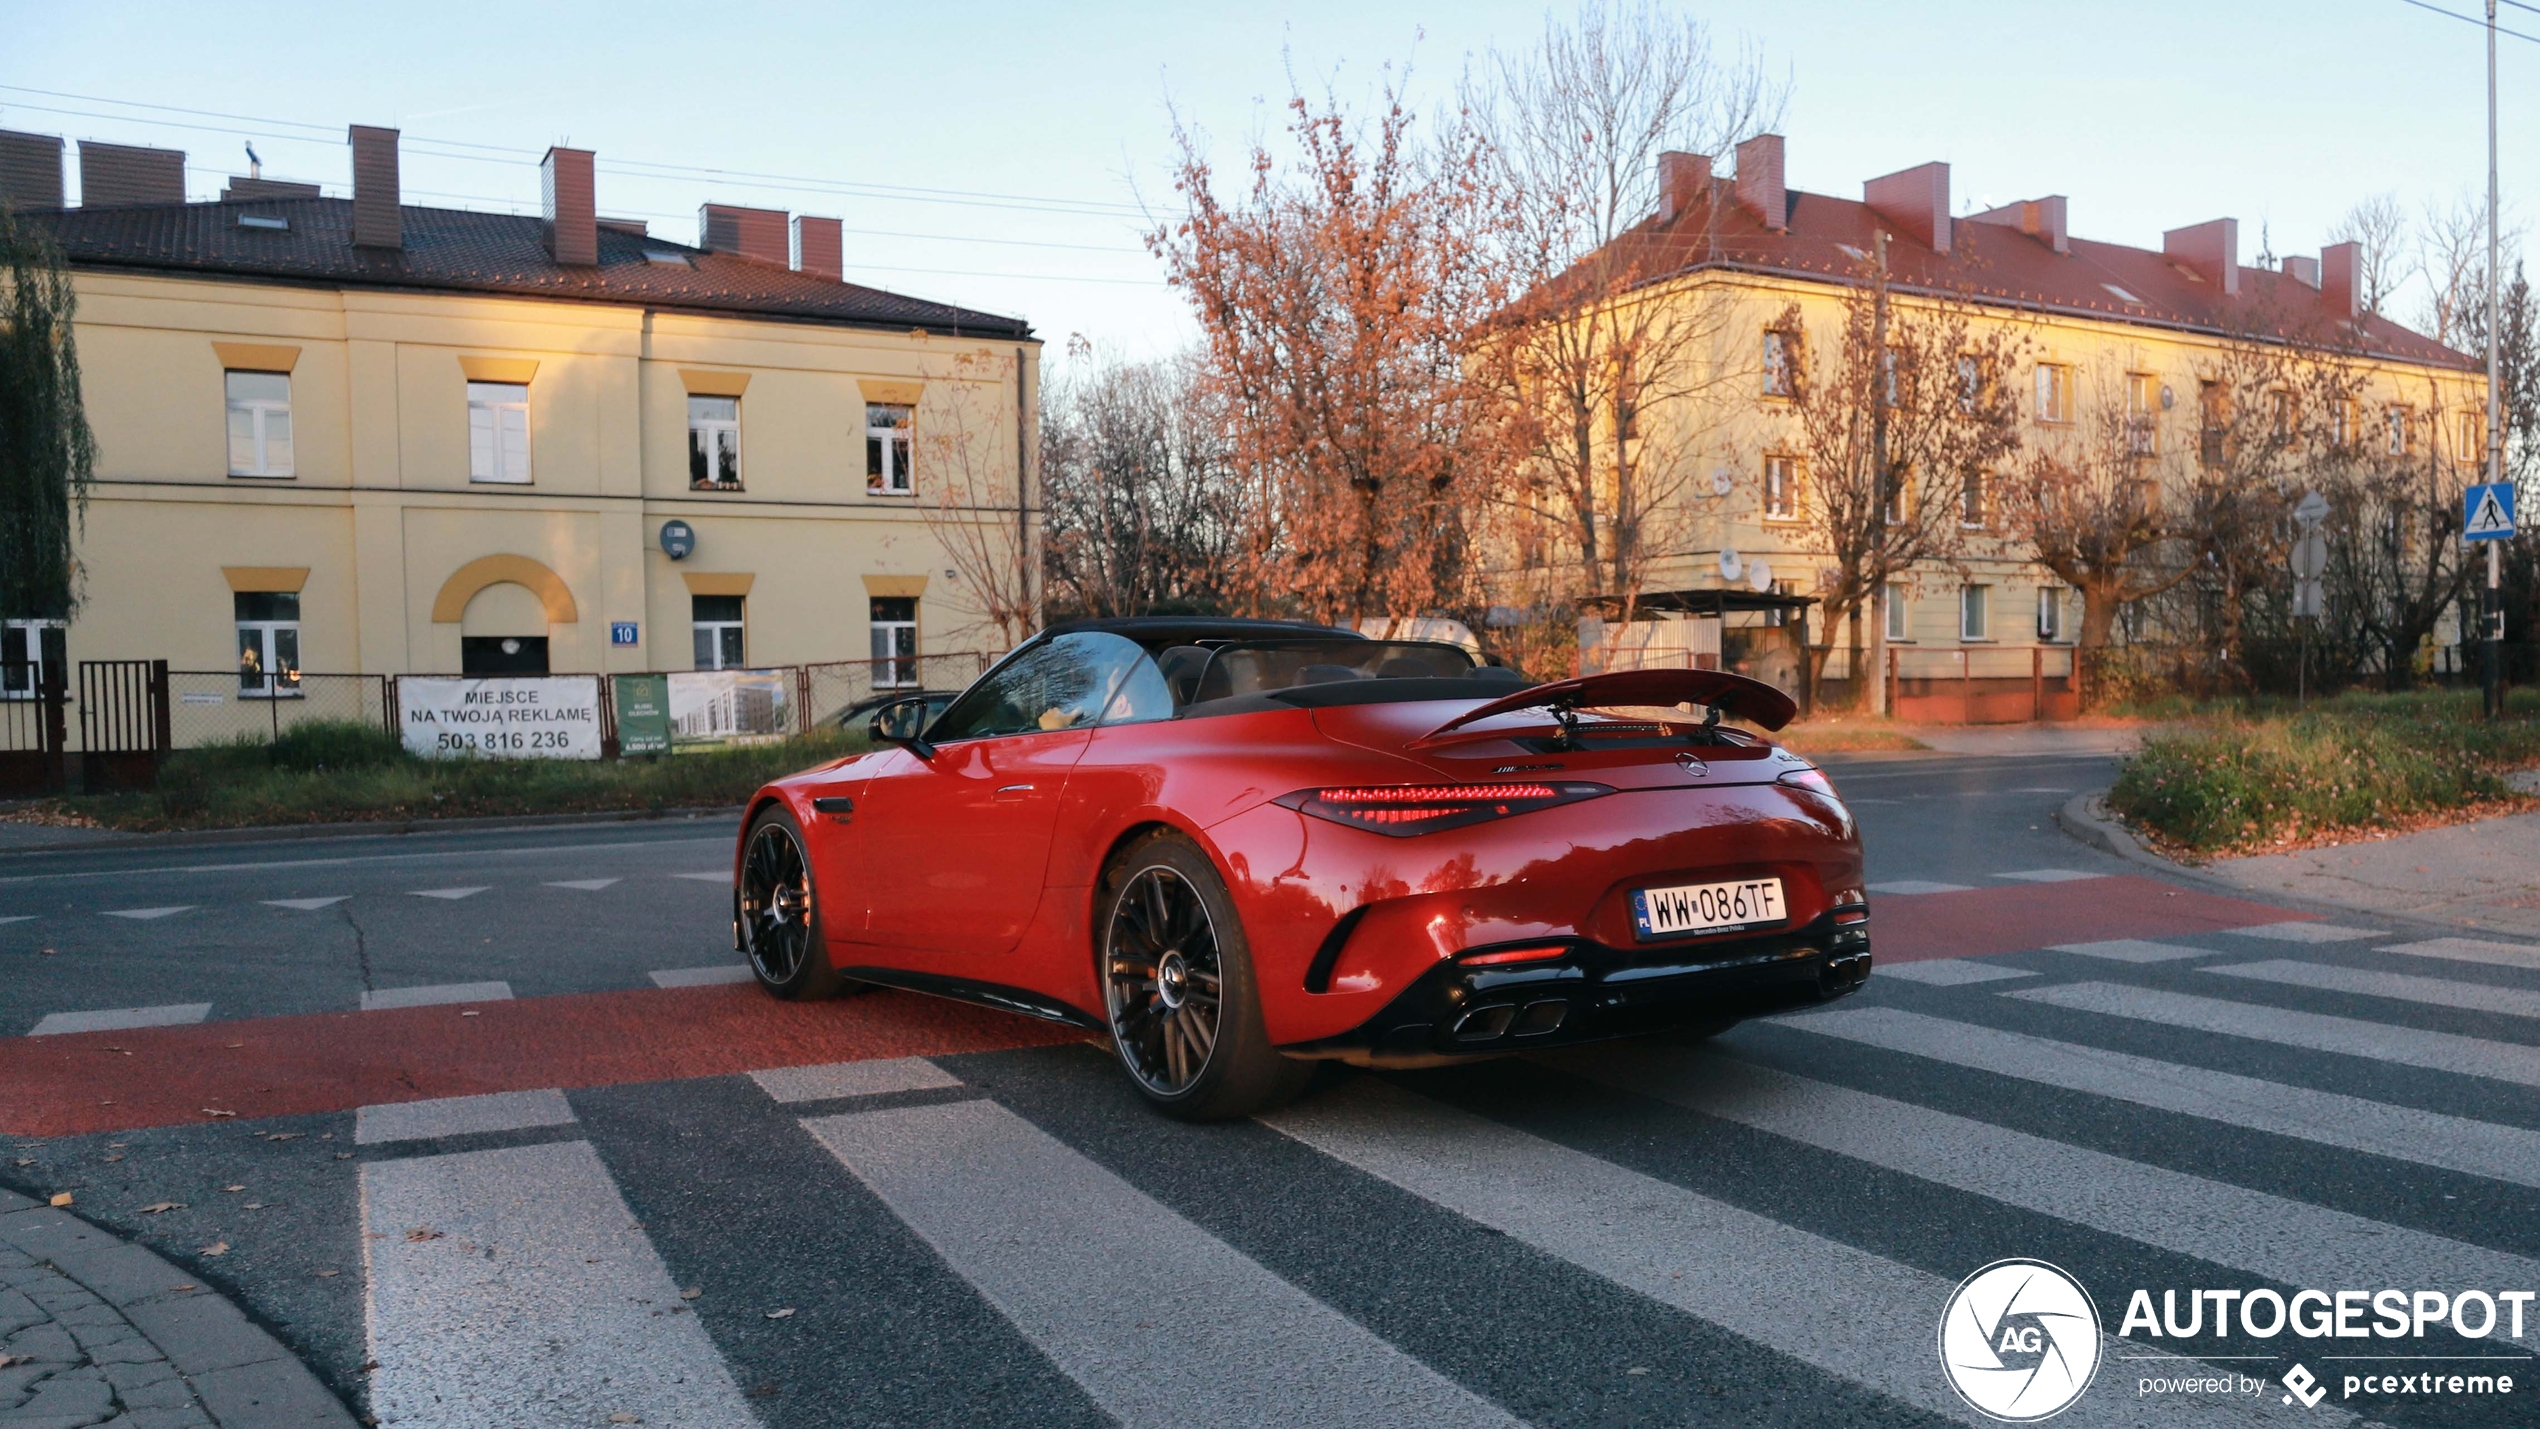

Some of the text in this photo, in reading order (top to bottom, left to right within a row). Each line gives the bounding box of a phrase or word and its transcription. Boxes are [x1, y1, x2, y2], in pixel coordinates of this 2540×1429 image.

[617, 627, 632, 642] 10
[465, 690, 539, 704] MIEJSCE
[411, 708, 591, 724] NA TWOJĄ REKLAMĘ
[437, 731, 569, 750] 503 816 236
[1653, 883, 1774, 928] WW 086TF
[1639, 918, 1650, 928] PL
